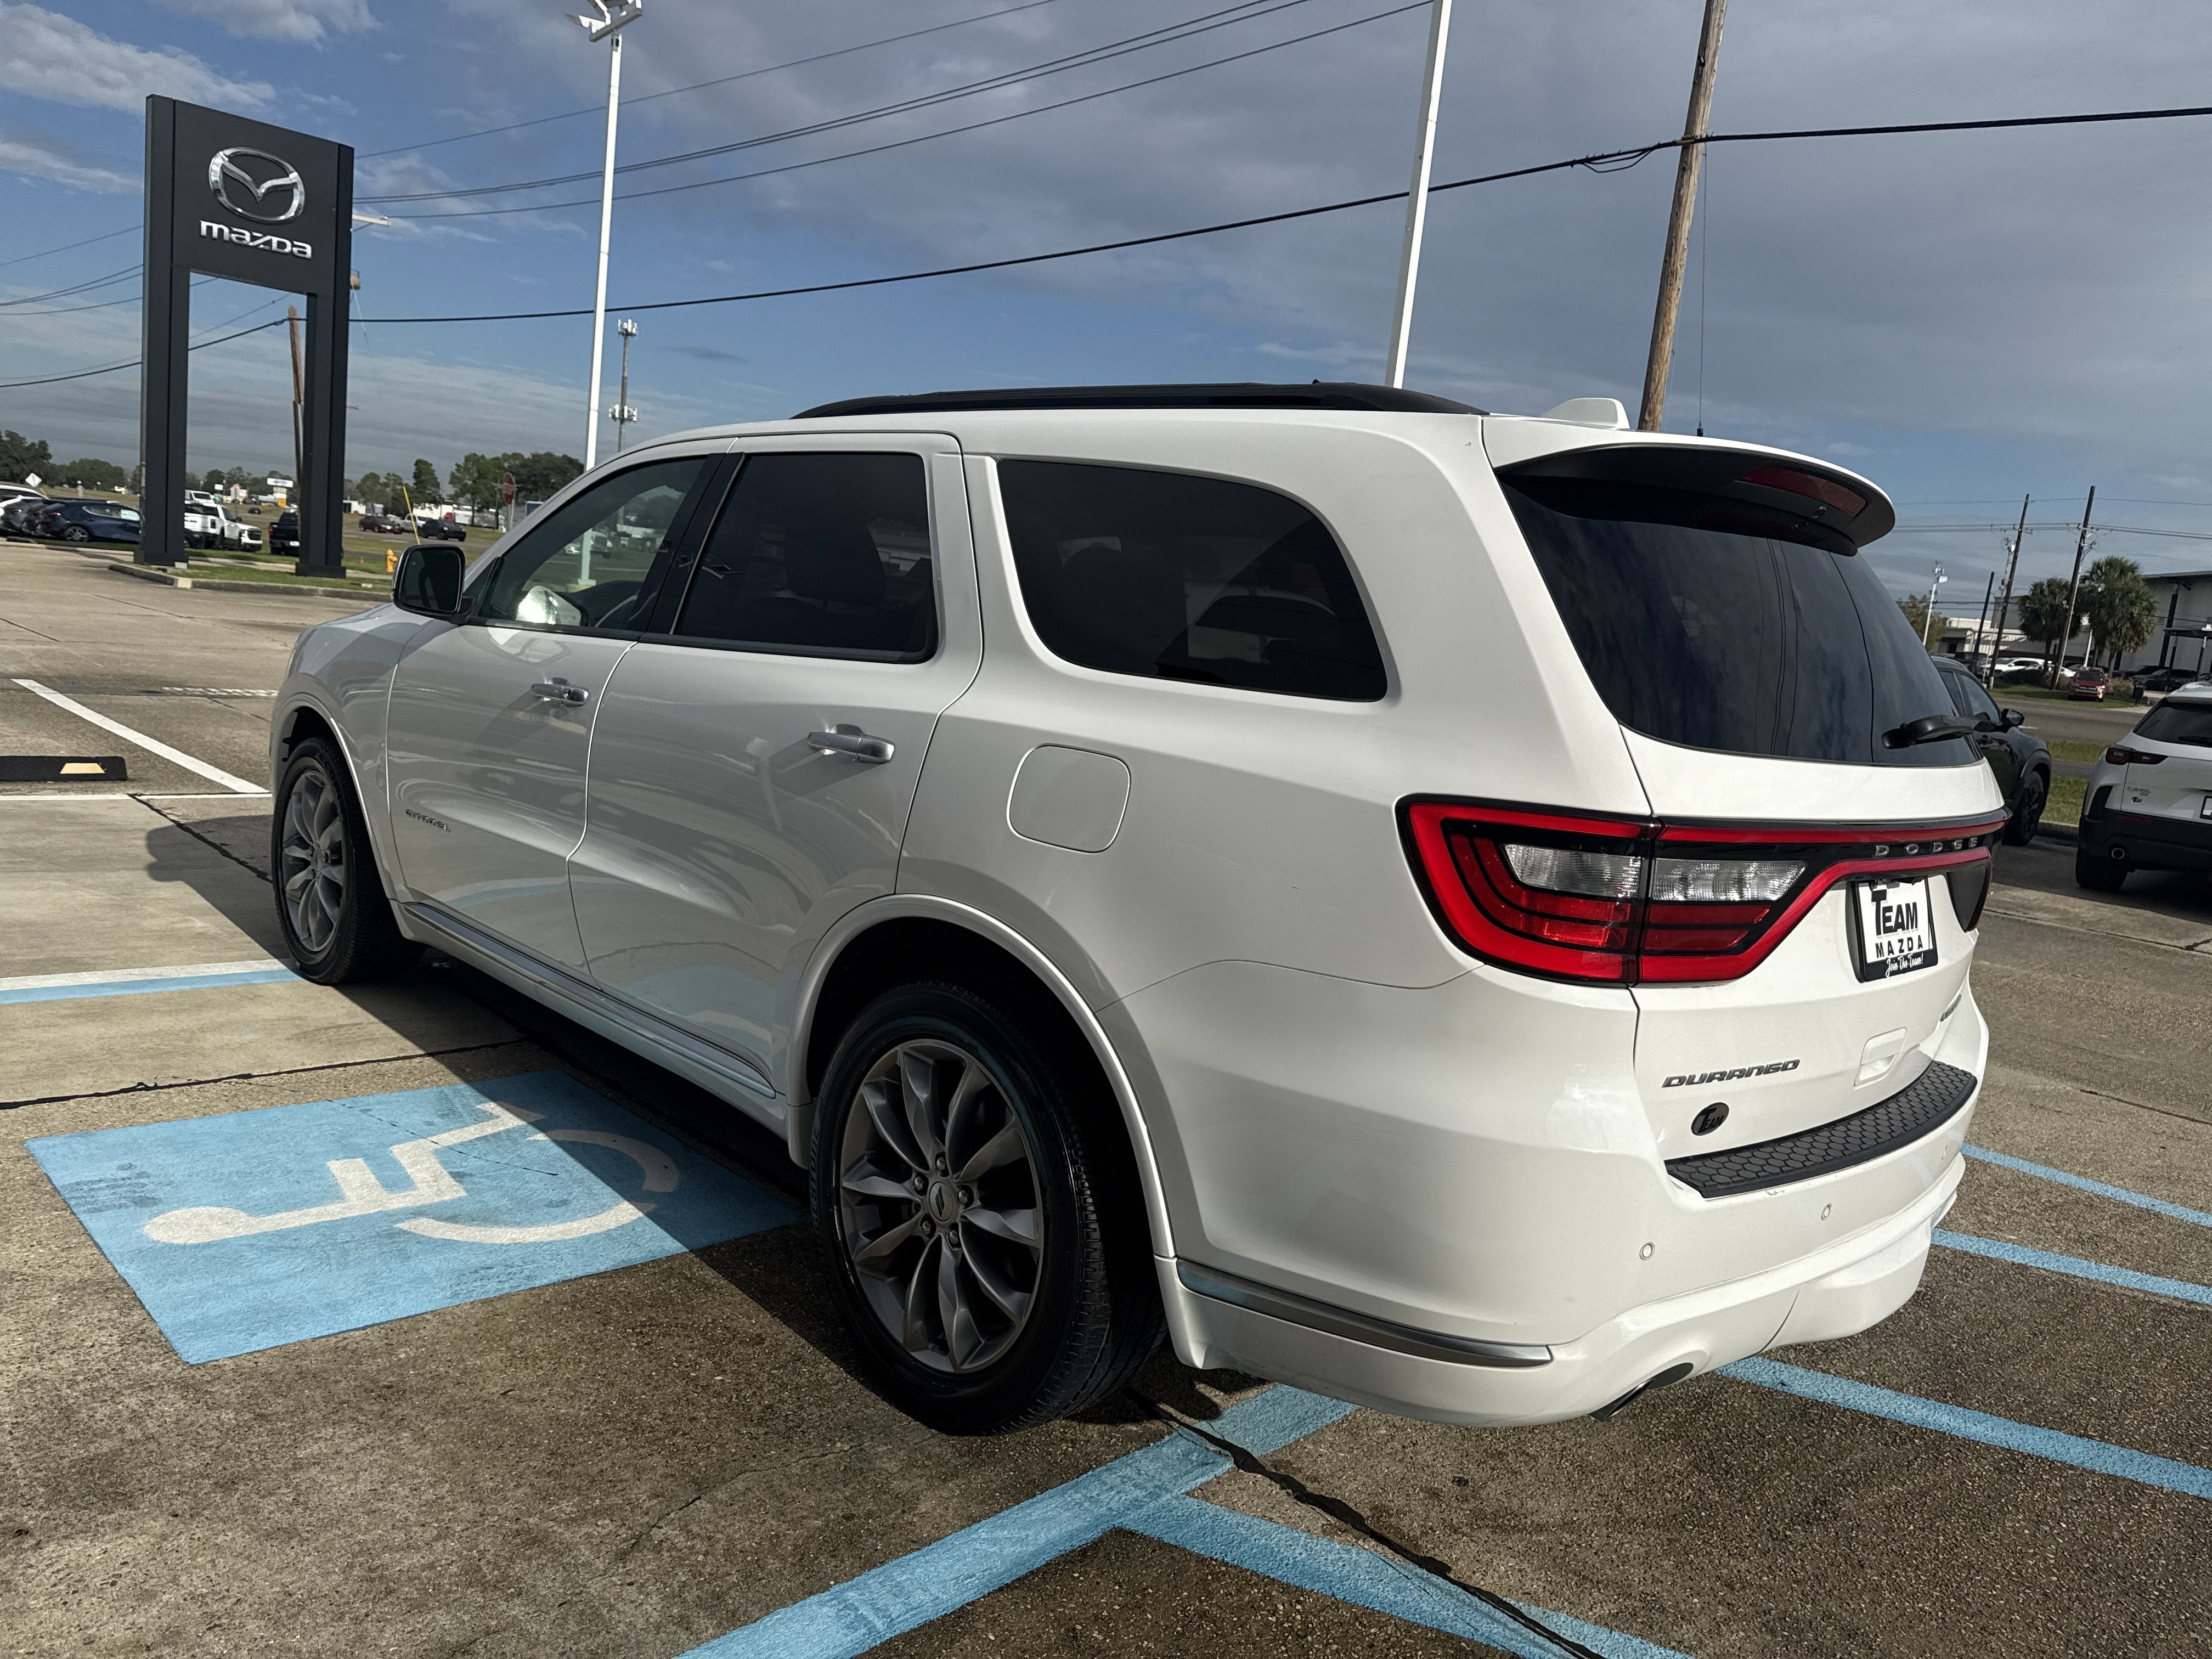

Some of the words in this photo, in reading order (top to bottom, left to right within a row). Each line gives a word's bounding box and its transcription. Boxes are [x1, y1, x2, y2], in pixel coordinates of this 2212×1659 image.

[1875, 837, 1978, 856] DODGE
[1871, 889, 1918, 936] TEAM
[1875, 935, 1923, 958] MAZDA
[1886, 958, 1899, 978] Join
[1898, 955, 1909, 970] The
[1908, 952, 1924, 968] Team!
[1661, 1059, 1801, 1088] DURANGO
